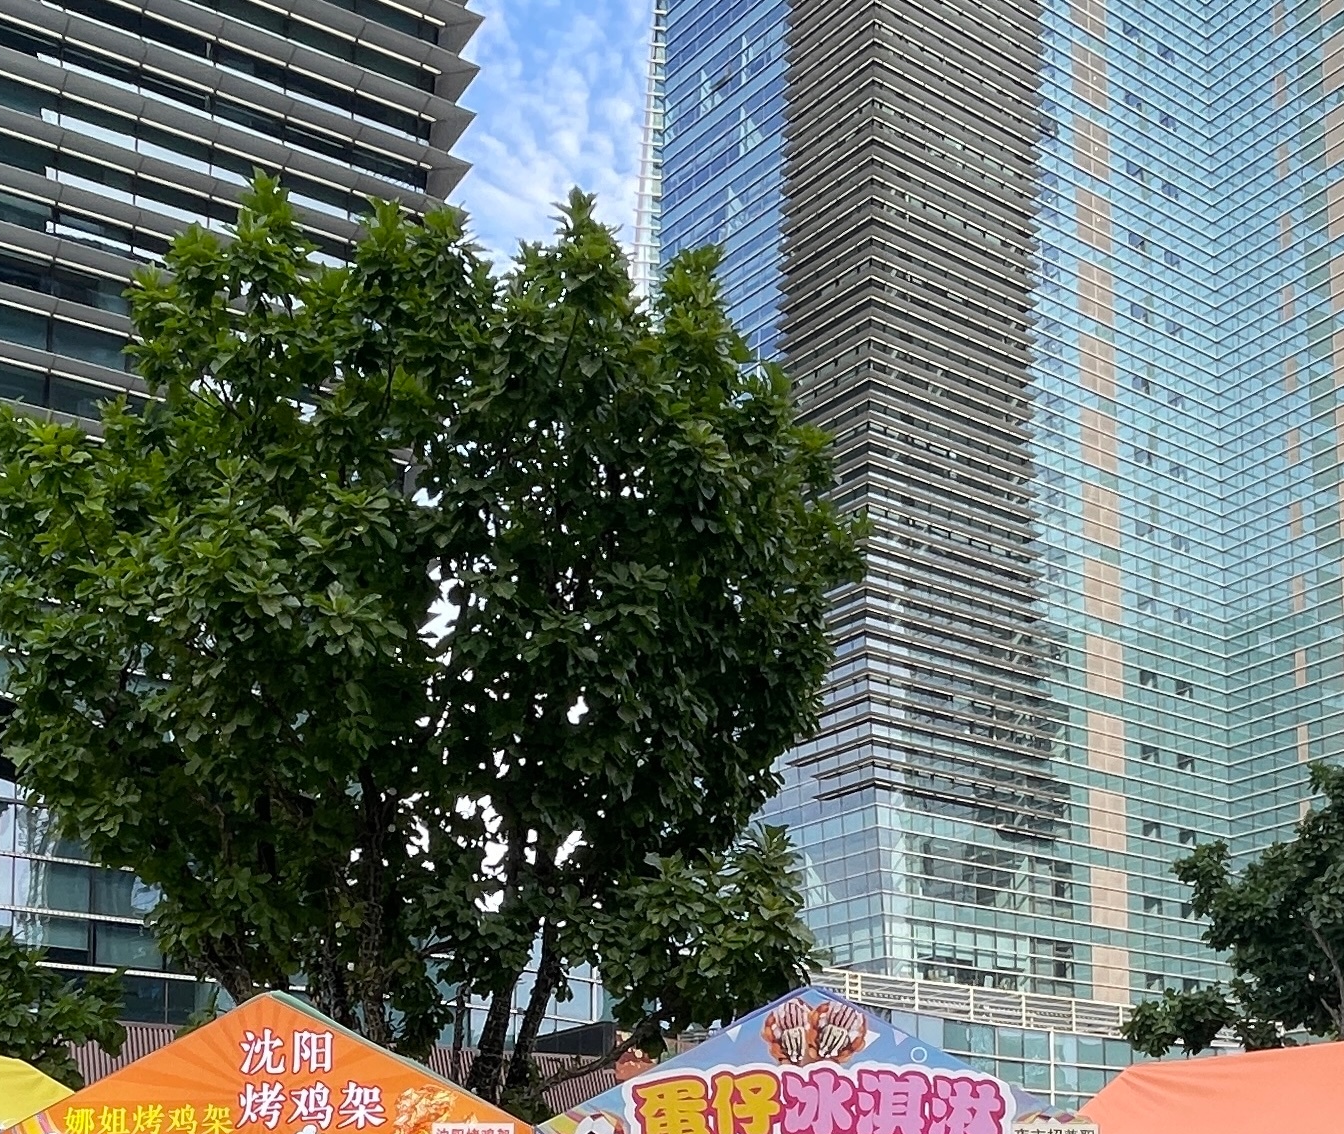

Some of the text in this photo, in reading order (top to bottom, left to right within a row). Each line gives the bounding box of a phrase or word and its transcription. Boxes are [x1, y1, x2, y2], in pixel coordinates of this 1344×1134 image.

[240, 1030, 334, 1076] 沈阳
[237, 1082, 388, 1131] 烤鸡架
